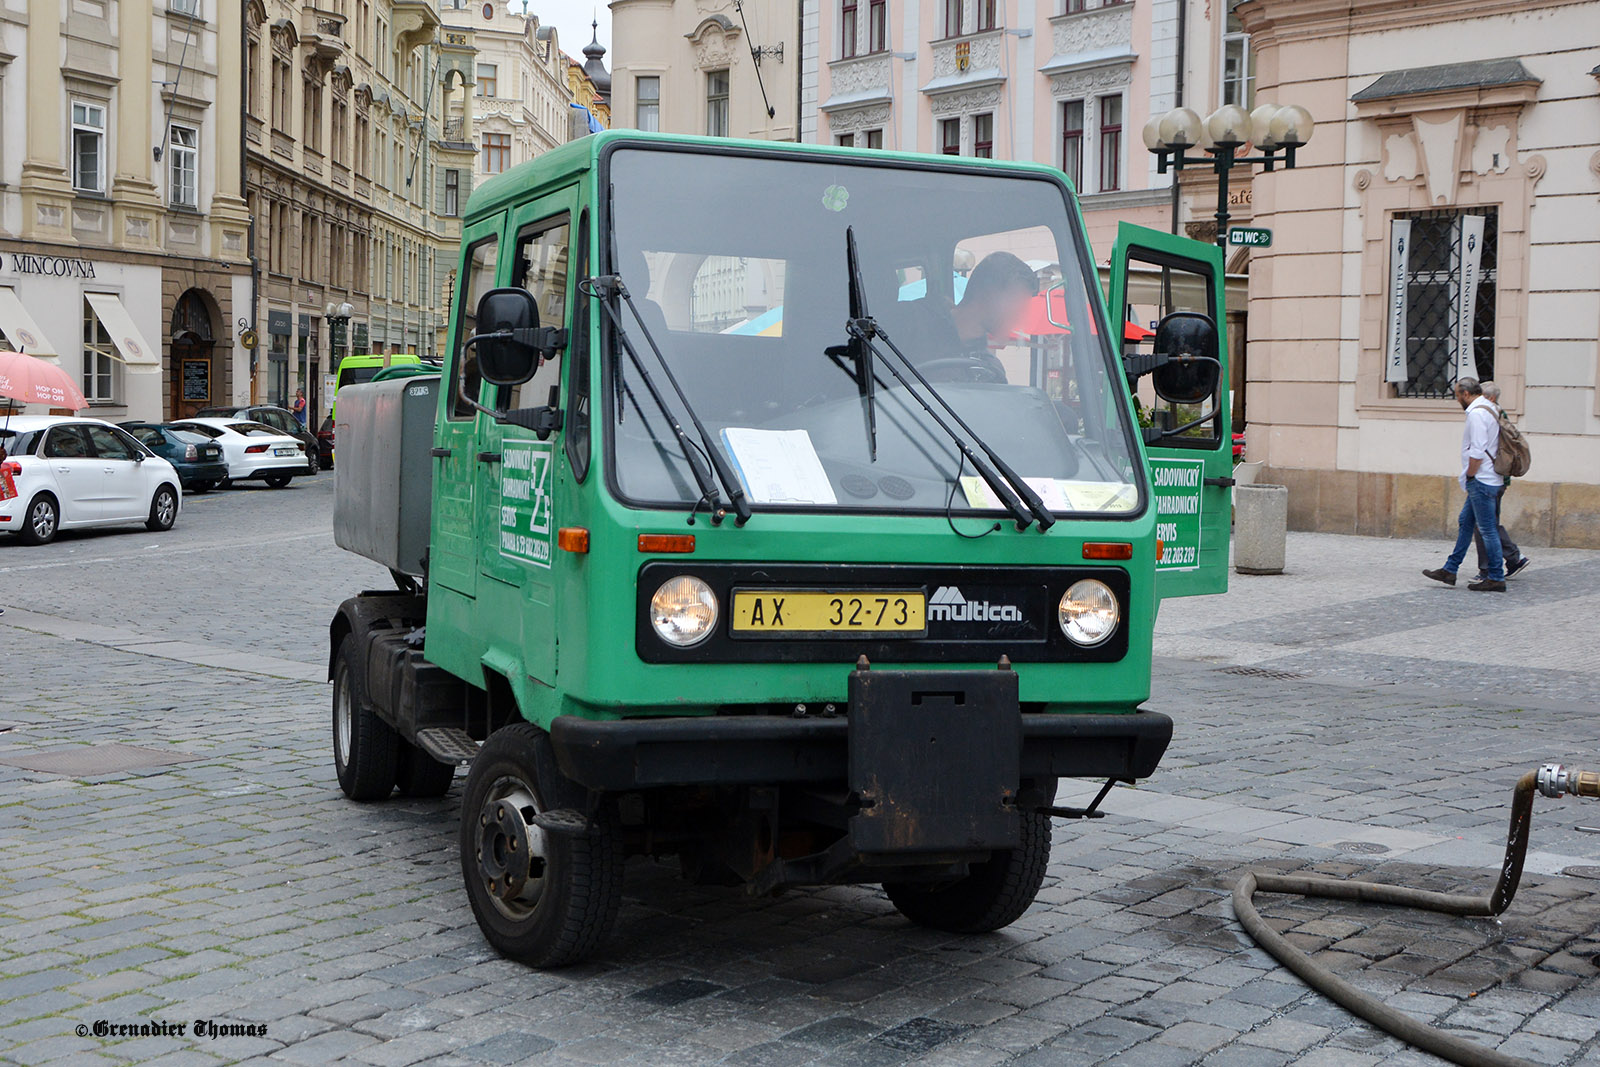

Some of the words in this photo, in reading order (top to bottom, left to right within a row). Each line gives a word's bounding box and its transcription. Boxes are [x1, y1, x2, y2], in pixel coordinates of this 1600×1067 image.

[1227, 190, 1252, 205] afé
[1244, 231, 1259, 243] WC
[11, 254, 96, 279] MINCOVNA
[1463, 261, 1473, 338] STATIONERY
[51, 387, 64, 395] ON
[52, 394, 65, 402] OFF
[1154, 465, 1200, 487] SADOVNICKÝ
[501, 505, 517, 527] SERVIS
[1156, 523, 1177, 541] ERVIS
[1171, 547, 1184, 564] 203
[1183, 546, 1195, 563] 219
[751, 598, 785, 625] AX
[829, 598, 908, 626] 32-73
